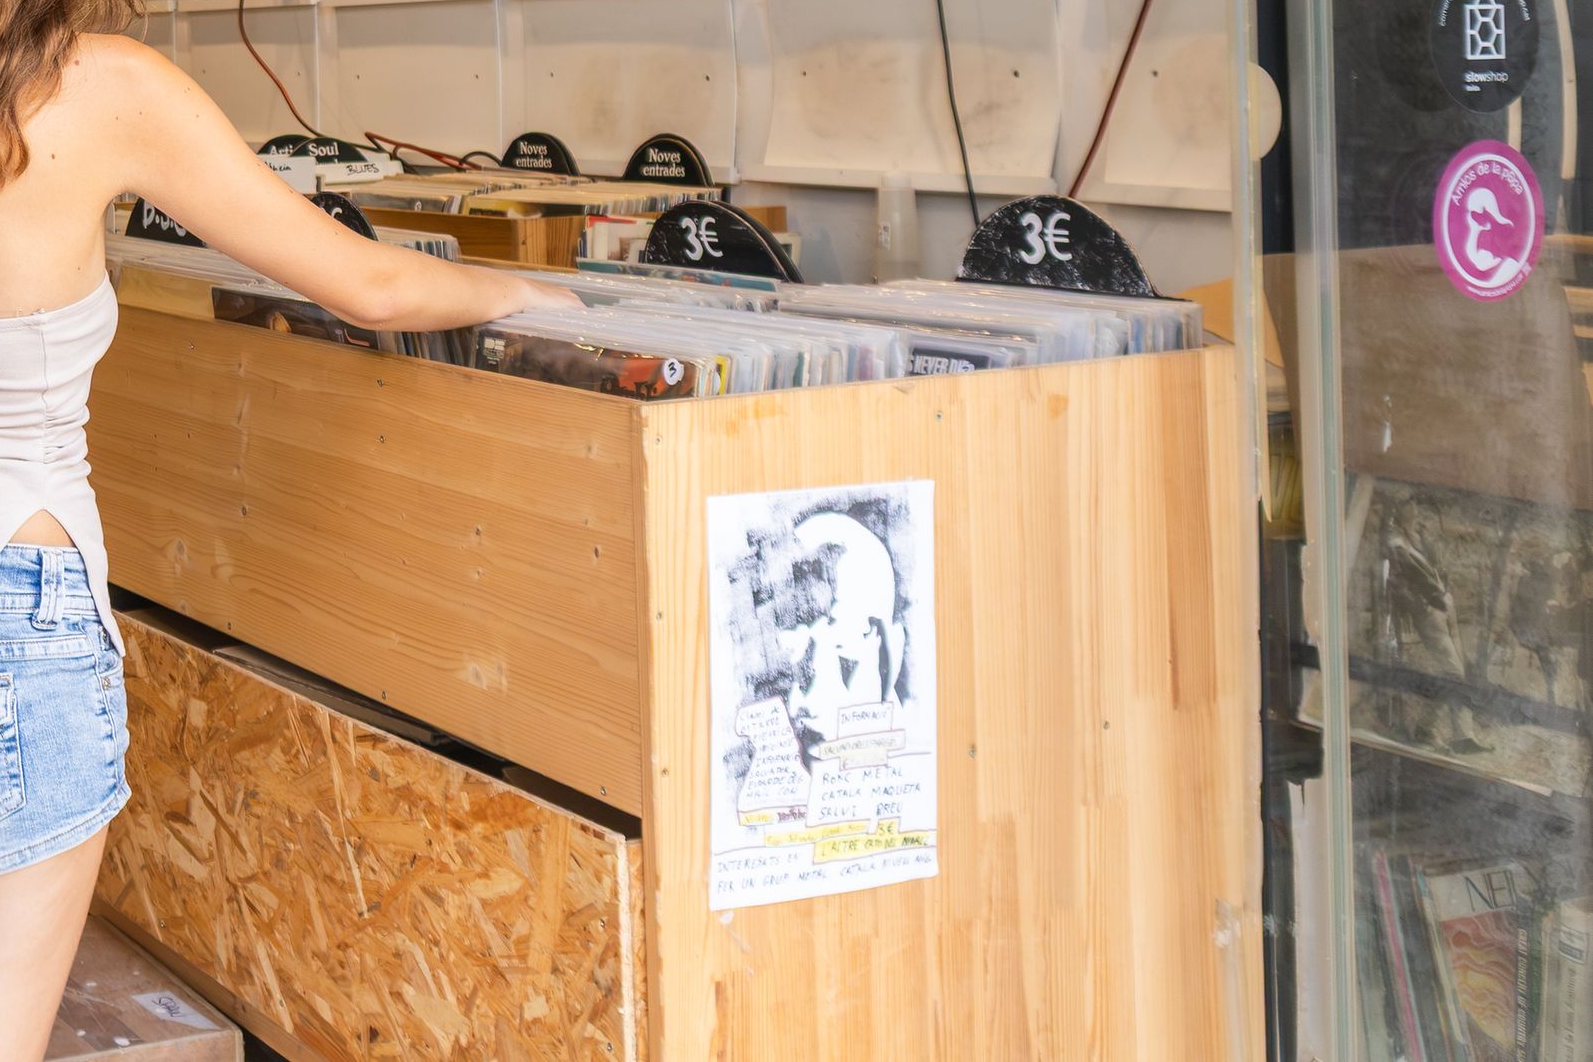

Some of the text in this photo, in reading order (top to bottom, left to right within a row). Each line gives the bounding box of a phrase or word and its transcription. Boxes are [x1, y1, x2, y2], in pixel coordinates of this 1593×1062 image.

[1463, 71, 1509, 84] slowshop
[308, 142, 340, 157] Soul
[518, 141, 549, 157] Noves
[647, 147, 682, 165] Noves
[345, 163, 380, 176] BLUES
[515, 156, 553, 170] entrades
[642, 162, 687, 179] entrades
[1477, 162, 1490, 176] de
[682, 216, 724, 261] 3€
[1018, 211, 1073, 265] 3€
[667, 361, 677, 377] 3
